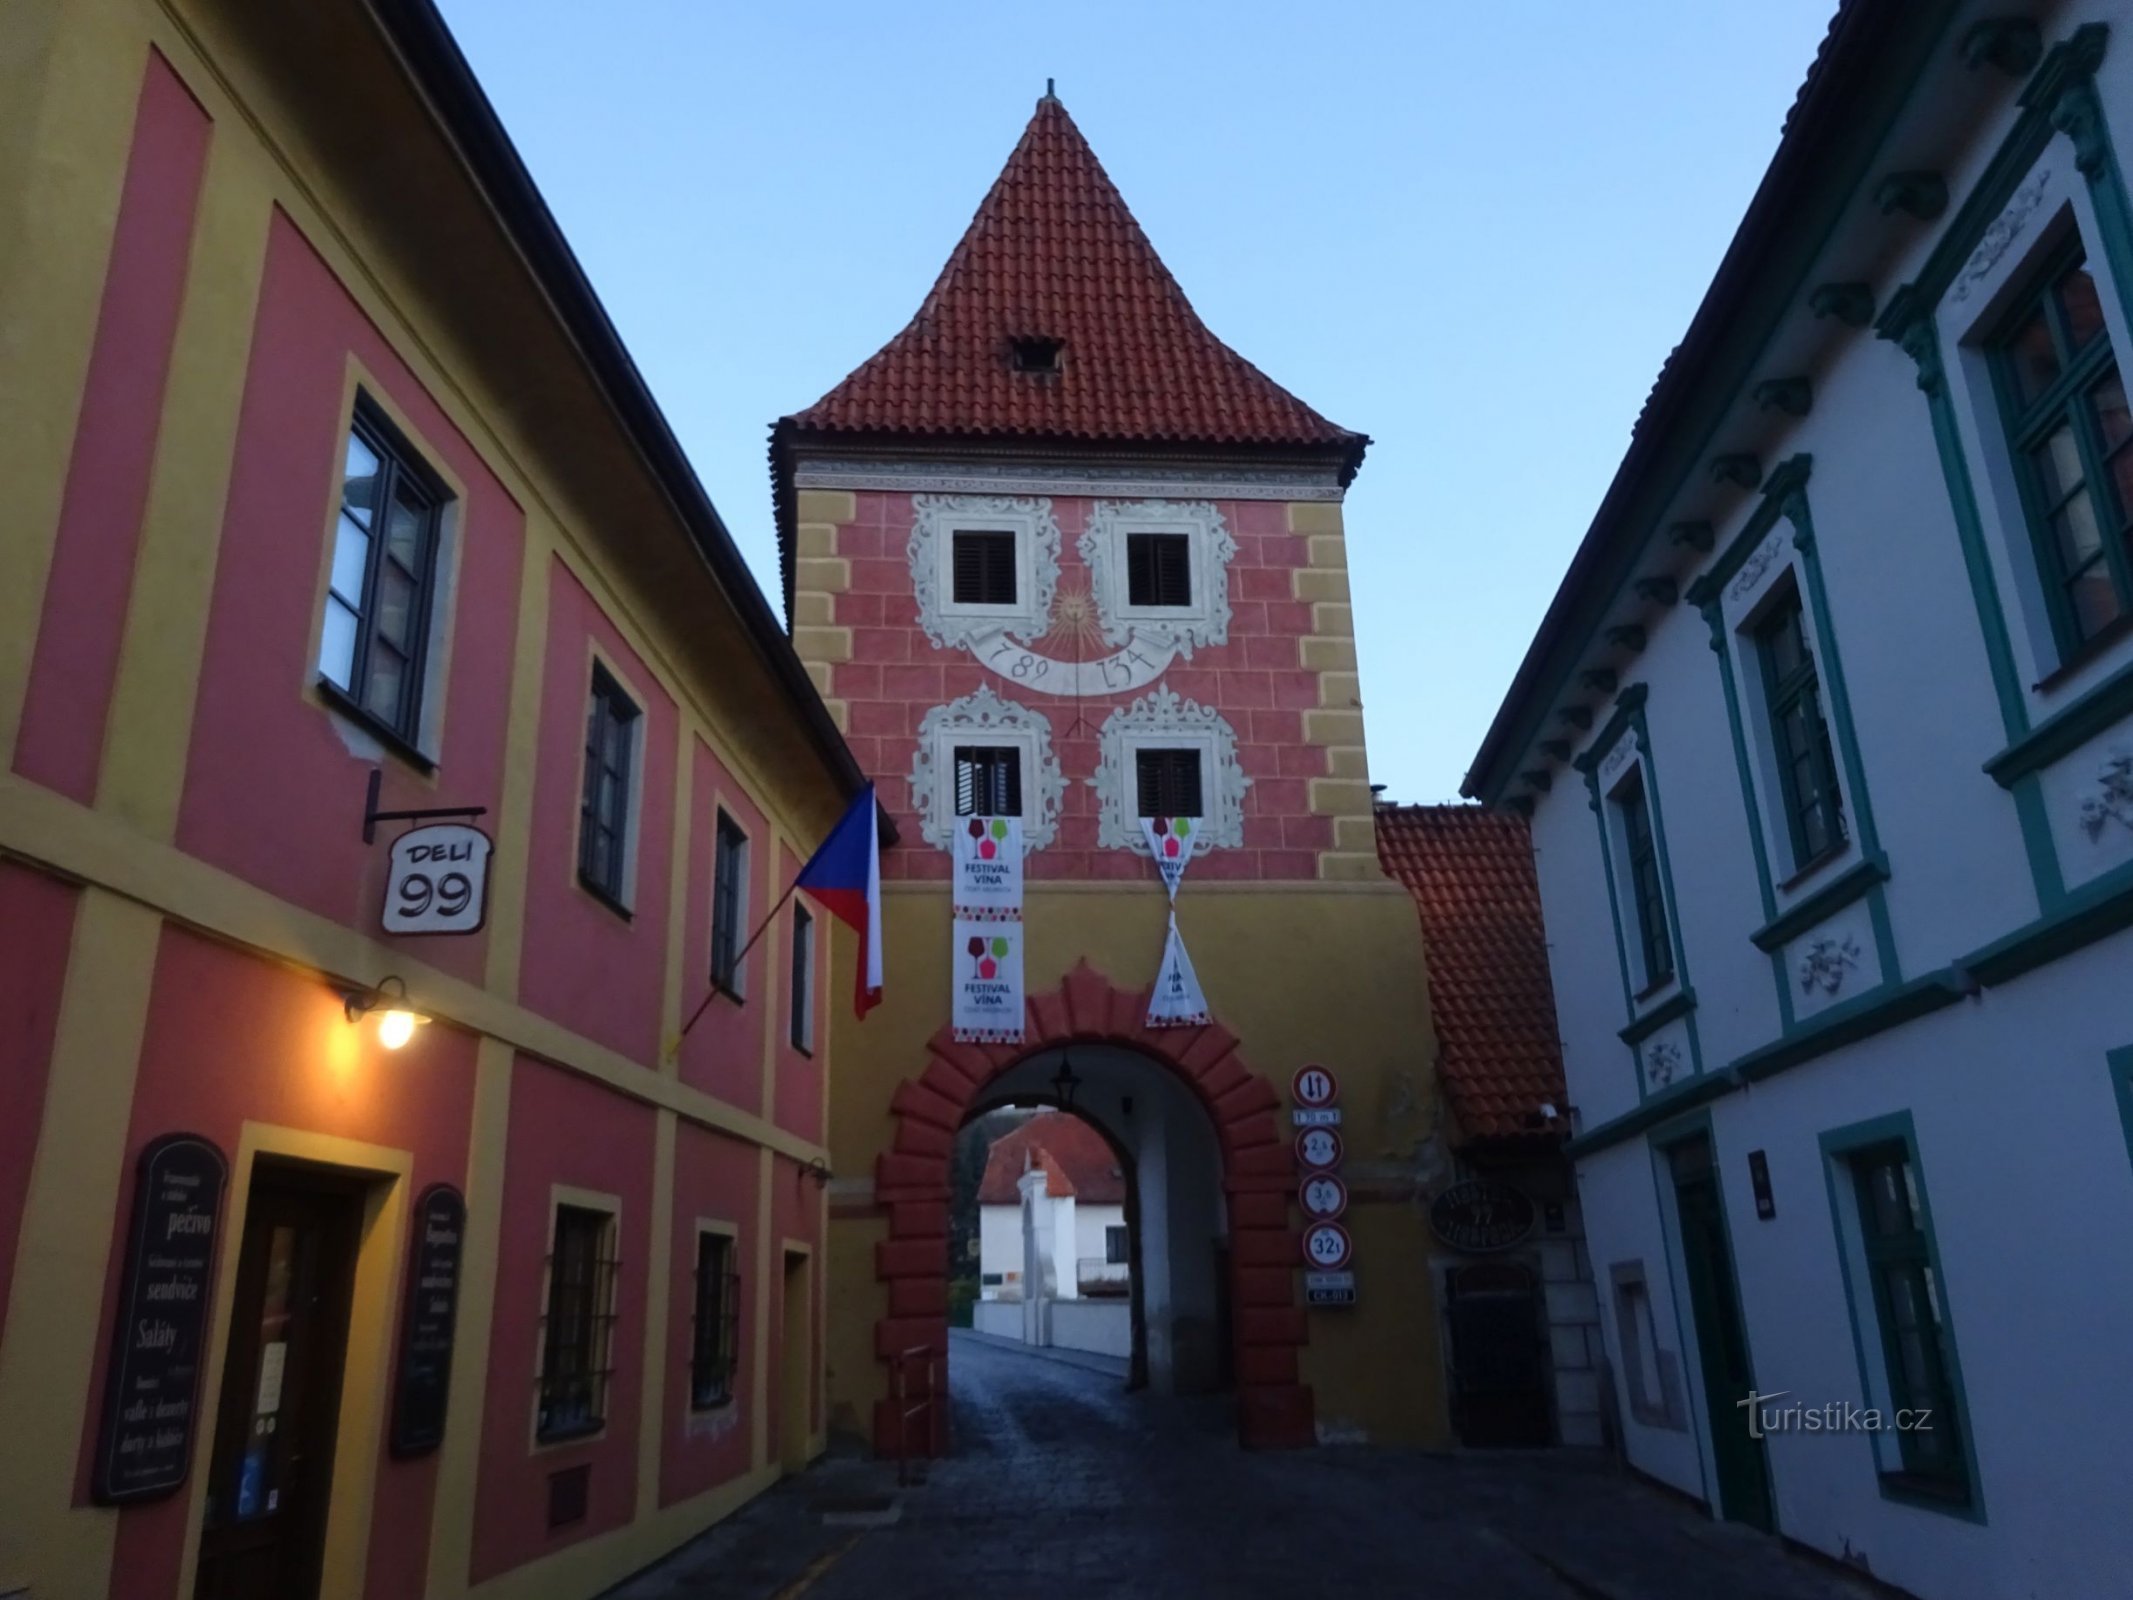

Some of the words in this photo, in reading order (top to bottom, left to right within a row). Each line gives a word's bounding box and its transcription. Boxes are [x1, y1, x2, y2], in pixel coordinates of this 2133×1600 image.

[405, 840, 474, 864] DELI
[965, 863, 1011, 874] FESTIVAL
[397, 871, 473, 918] 99
[964, 983, 1011, 994] FESTIVAL
[136, 1318, 178, 1355] Saláty
